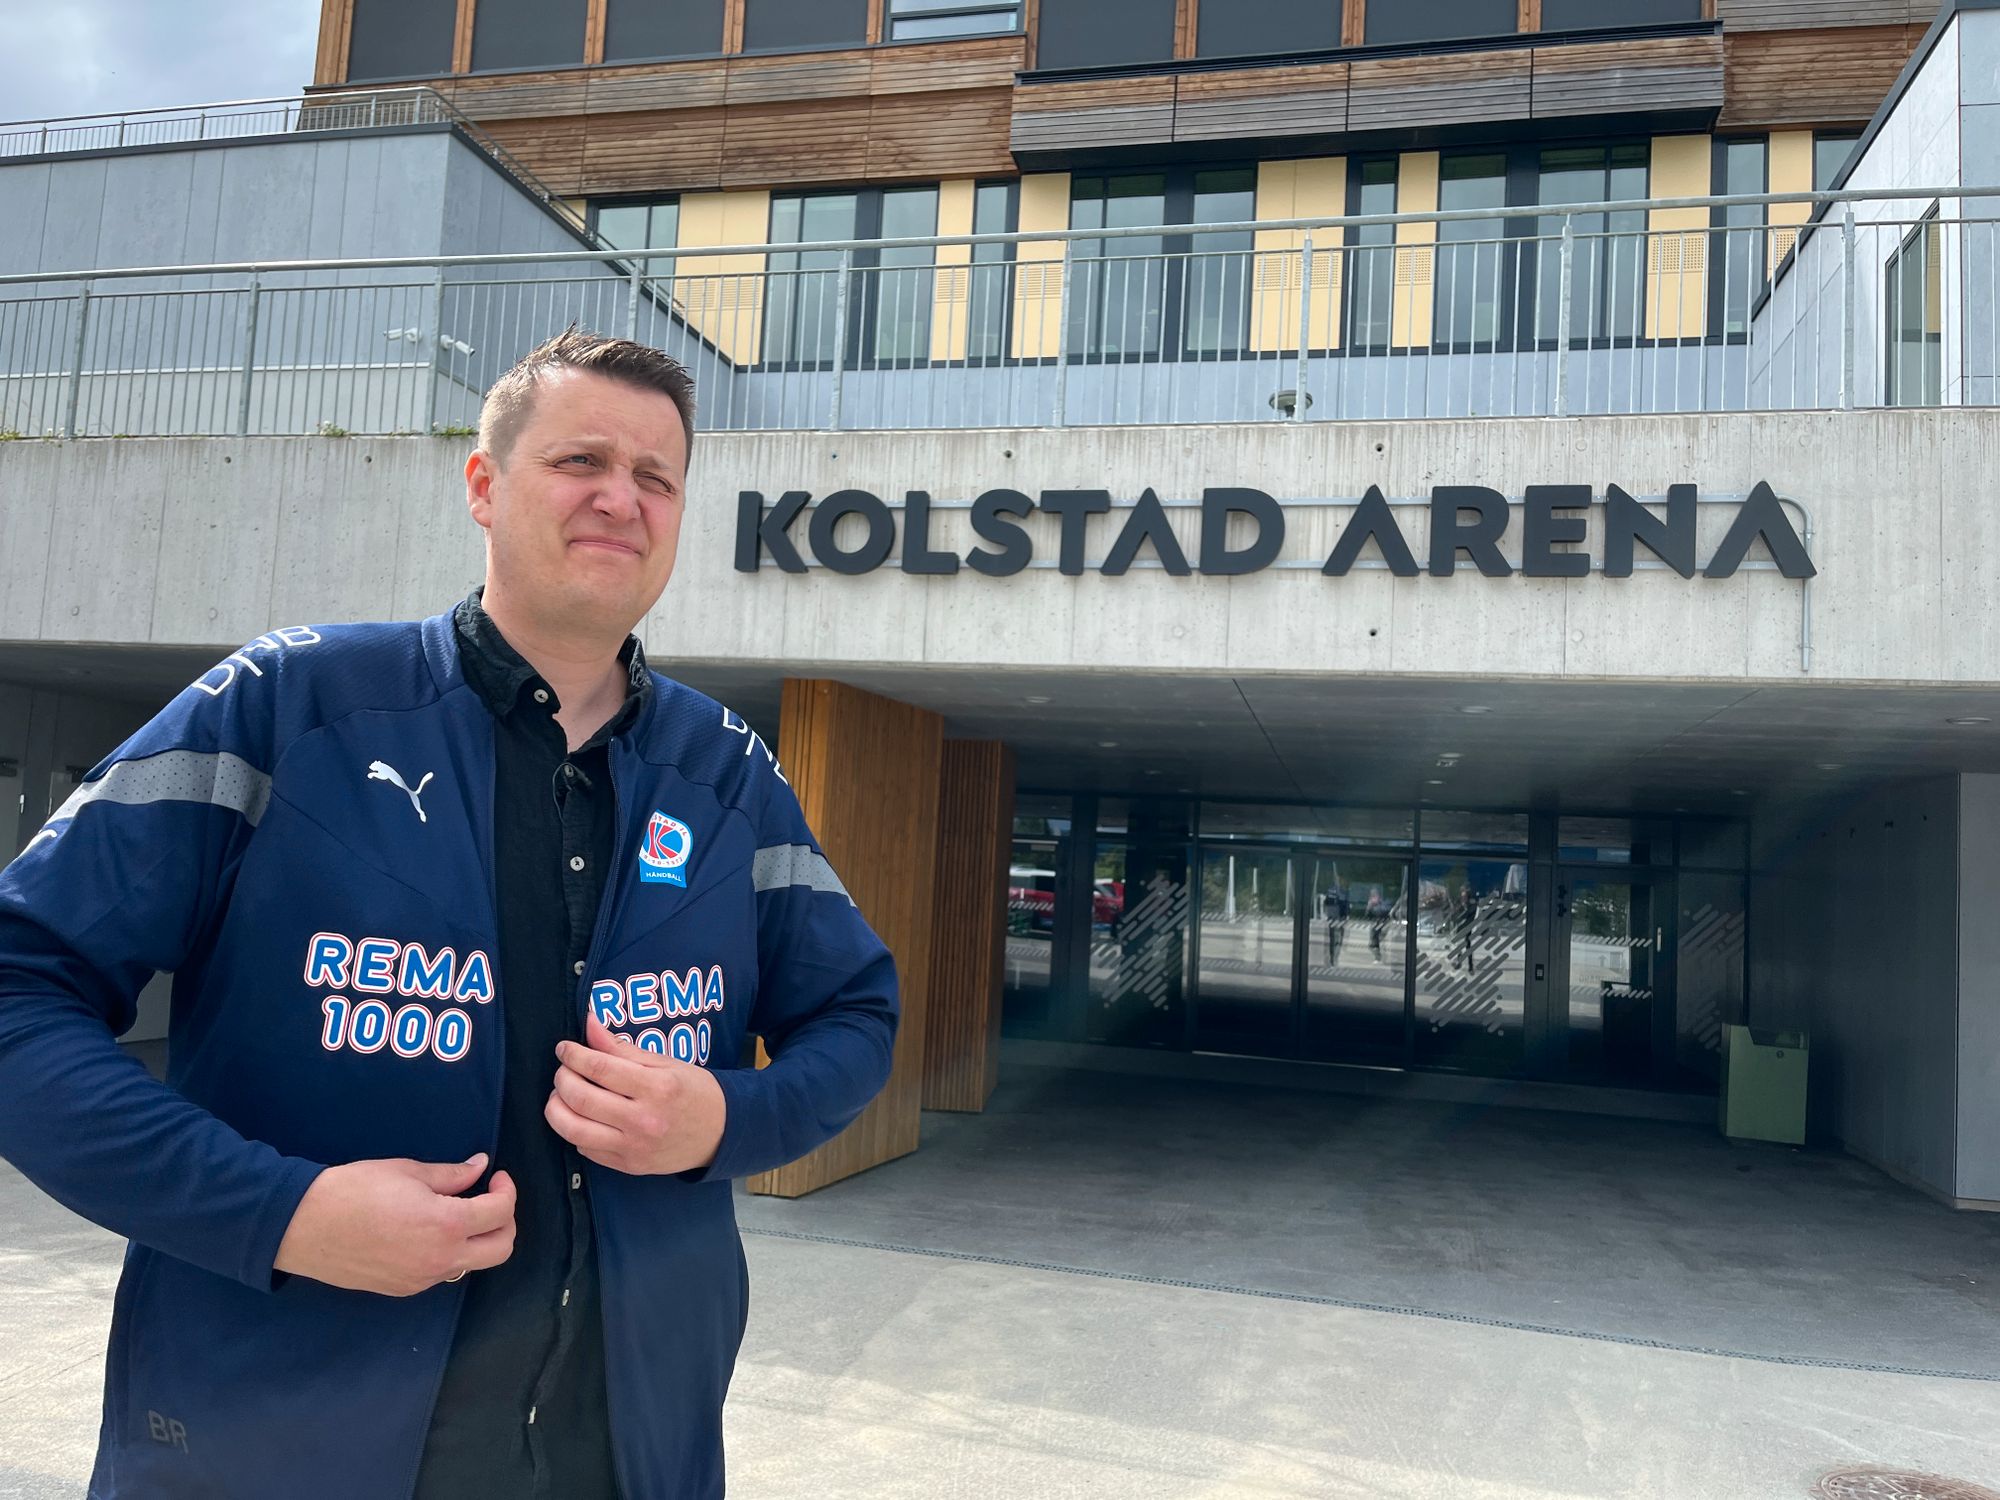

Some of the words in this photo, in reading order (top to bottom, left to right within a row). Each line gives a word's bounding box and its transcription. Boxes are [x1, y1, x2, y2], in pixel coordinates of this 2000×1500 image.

[734, 487, 1286, 577] KOLSTAD
[1321, 480, 1818, 580] ARENA
[191, 625, 322, 696] DNB
[303, 931, 495, 1004] REMA
[588, 964, 725, 1028] REMA
[321, 995, 473, 1062] 1000
[614, 1018, 712, 1066] 000
[148, 1409, 190, 1455] BR
